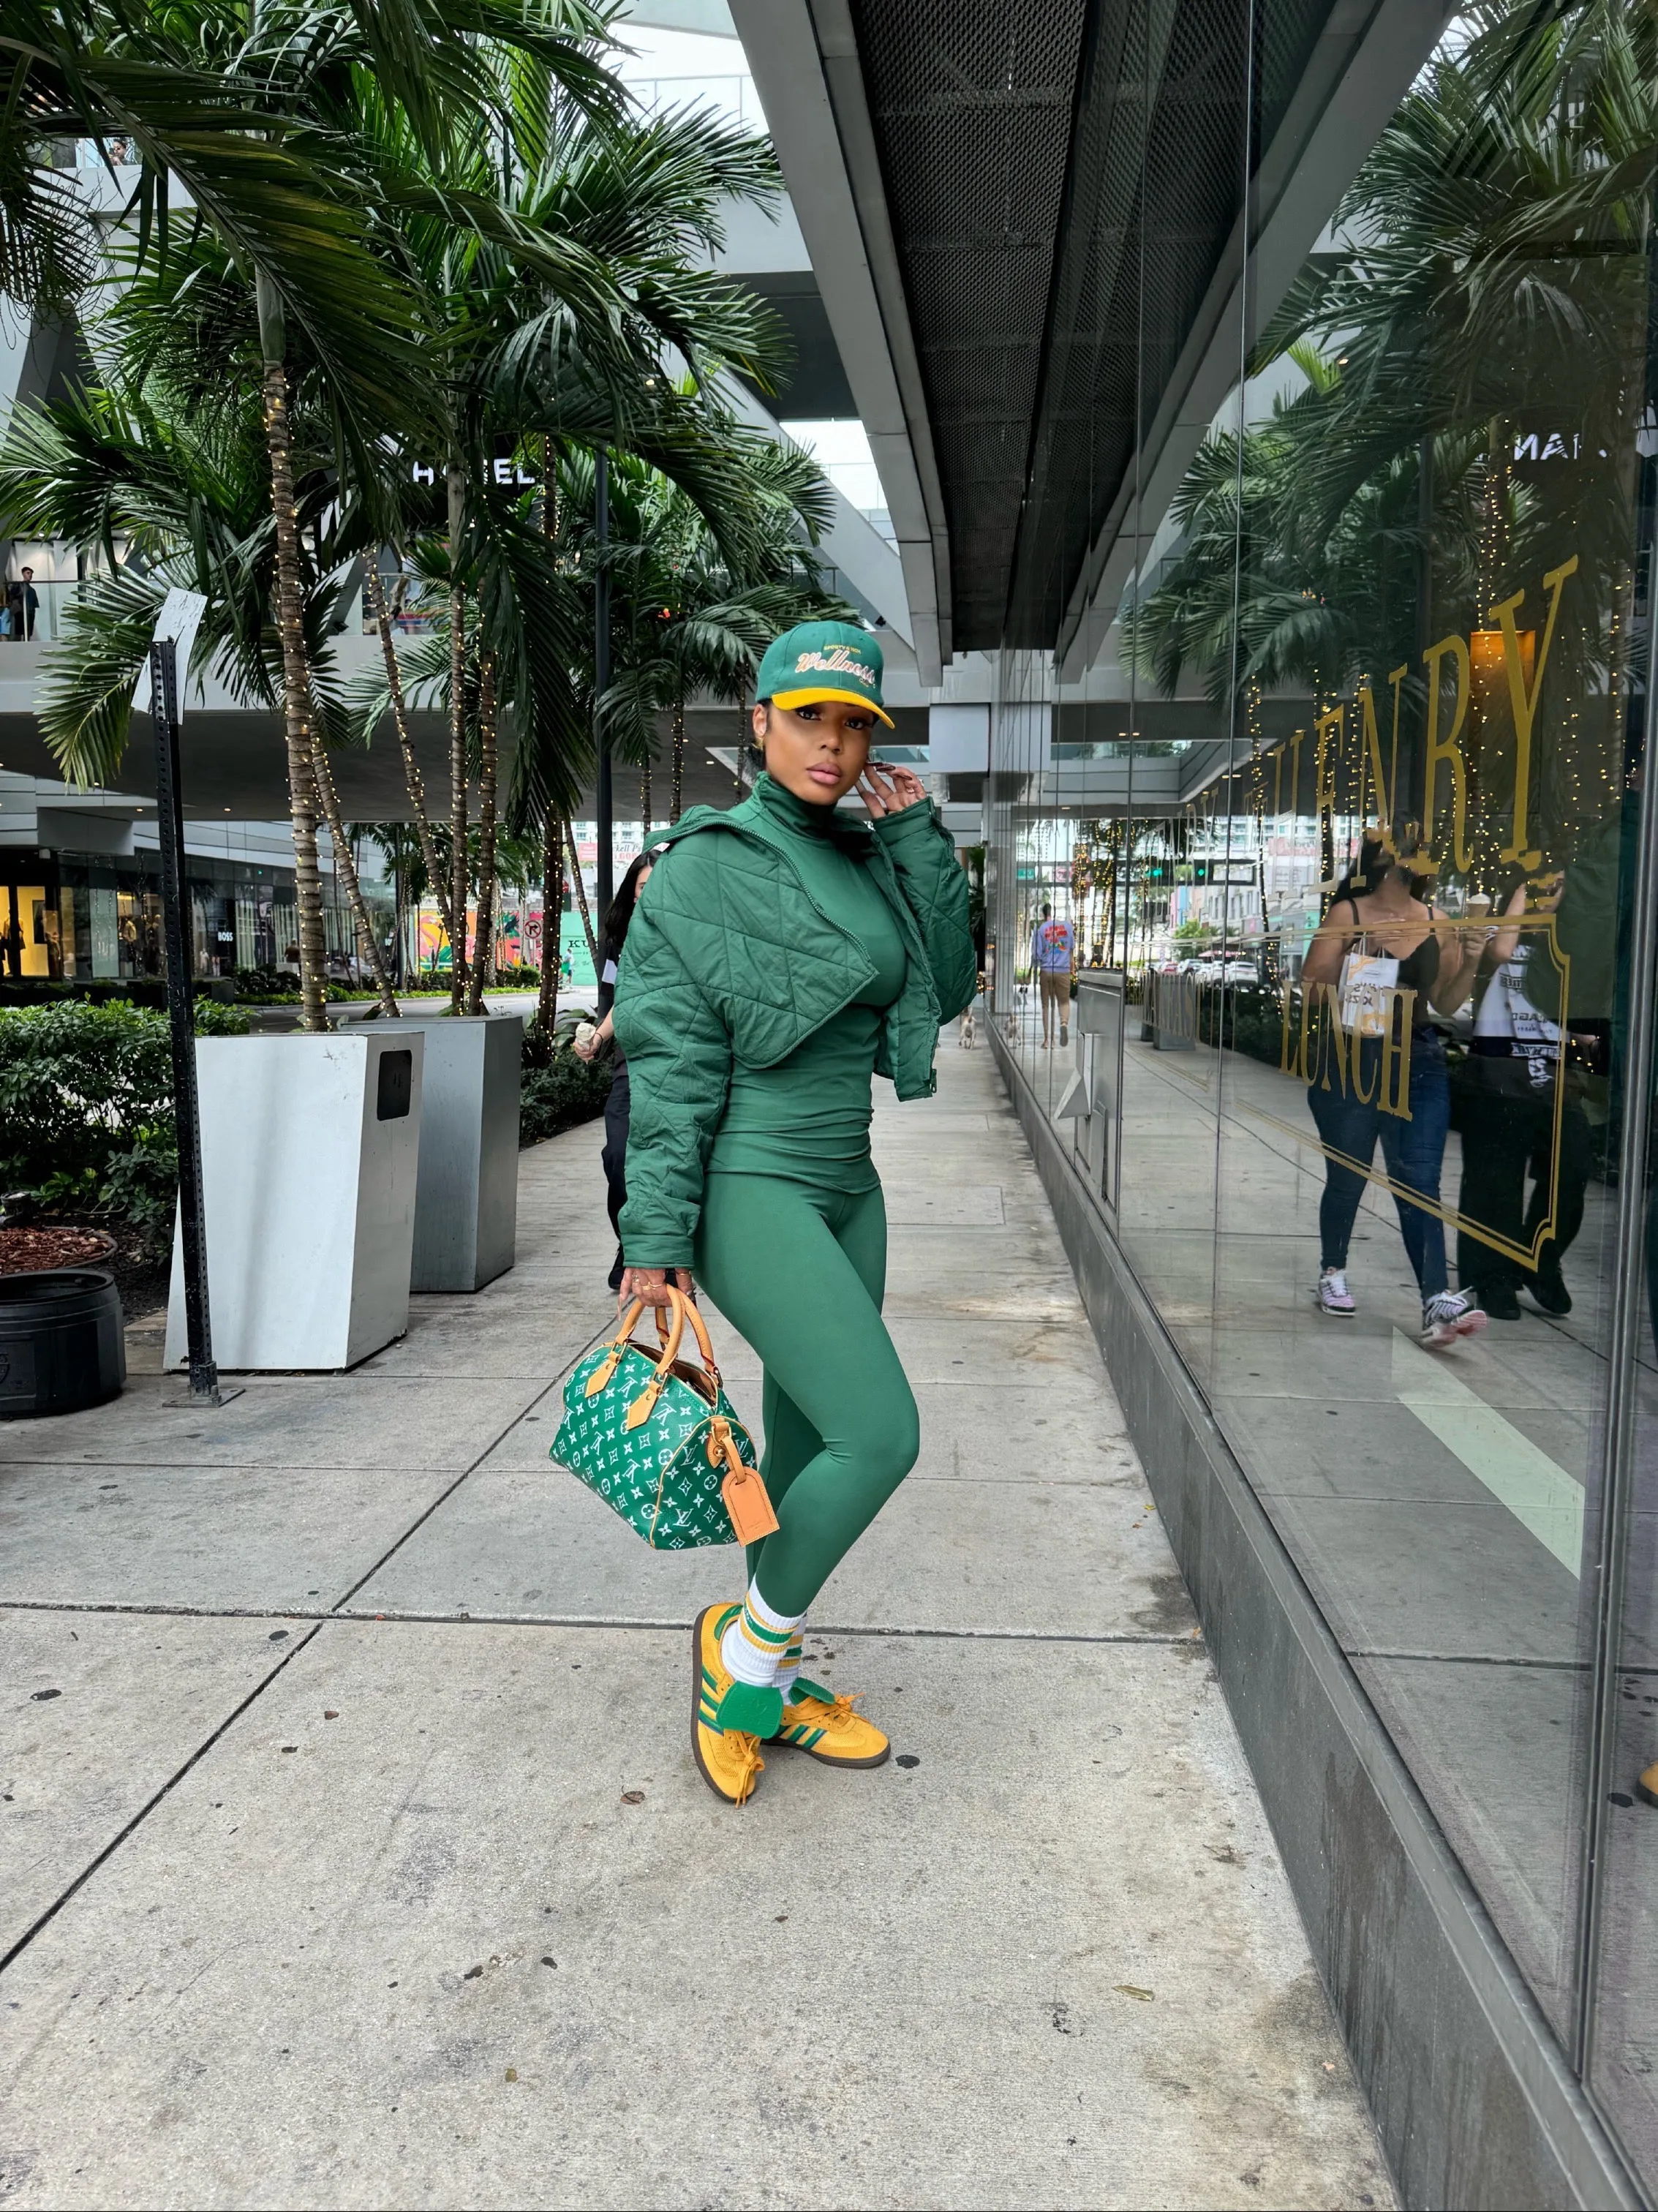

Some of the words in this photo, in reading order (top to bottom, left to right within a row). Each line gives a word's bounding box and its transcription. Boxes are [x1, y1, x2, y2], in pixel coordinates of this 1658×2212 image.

[795, 649, 875, 684] Wellness
[1267, 554, 1578, 902] HENRY
[217, 931, 233, 941] BOSS
[1279, 980, 1419, 1121] LUNCH
